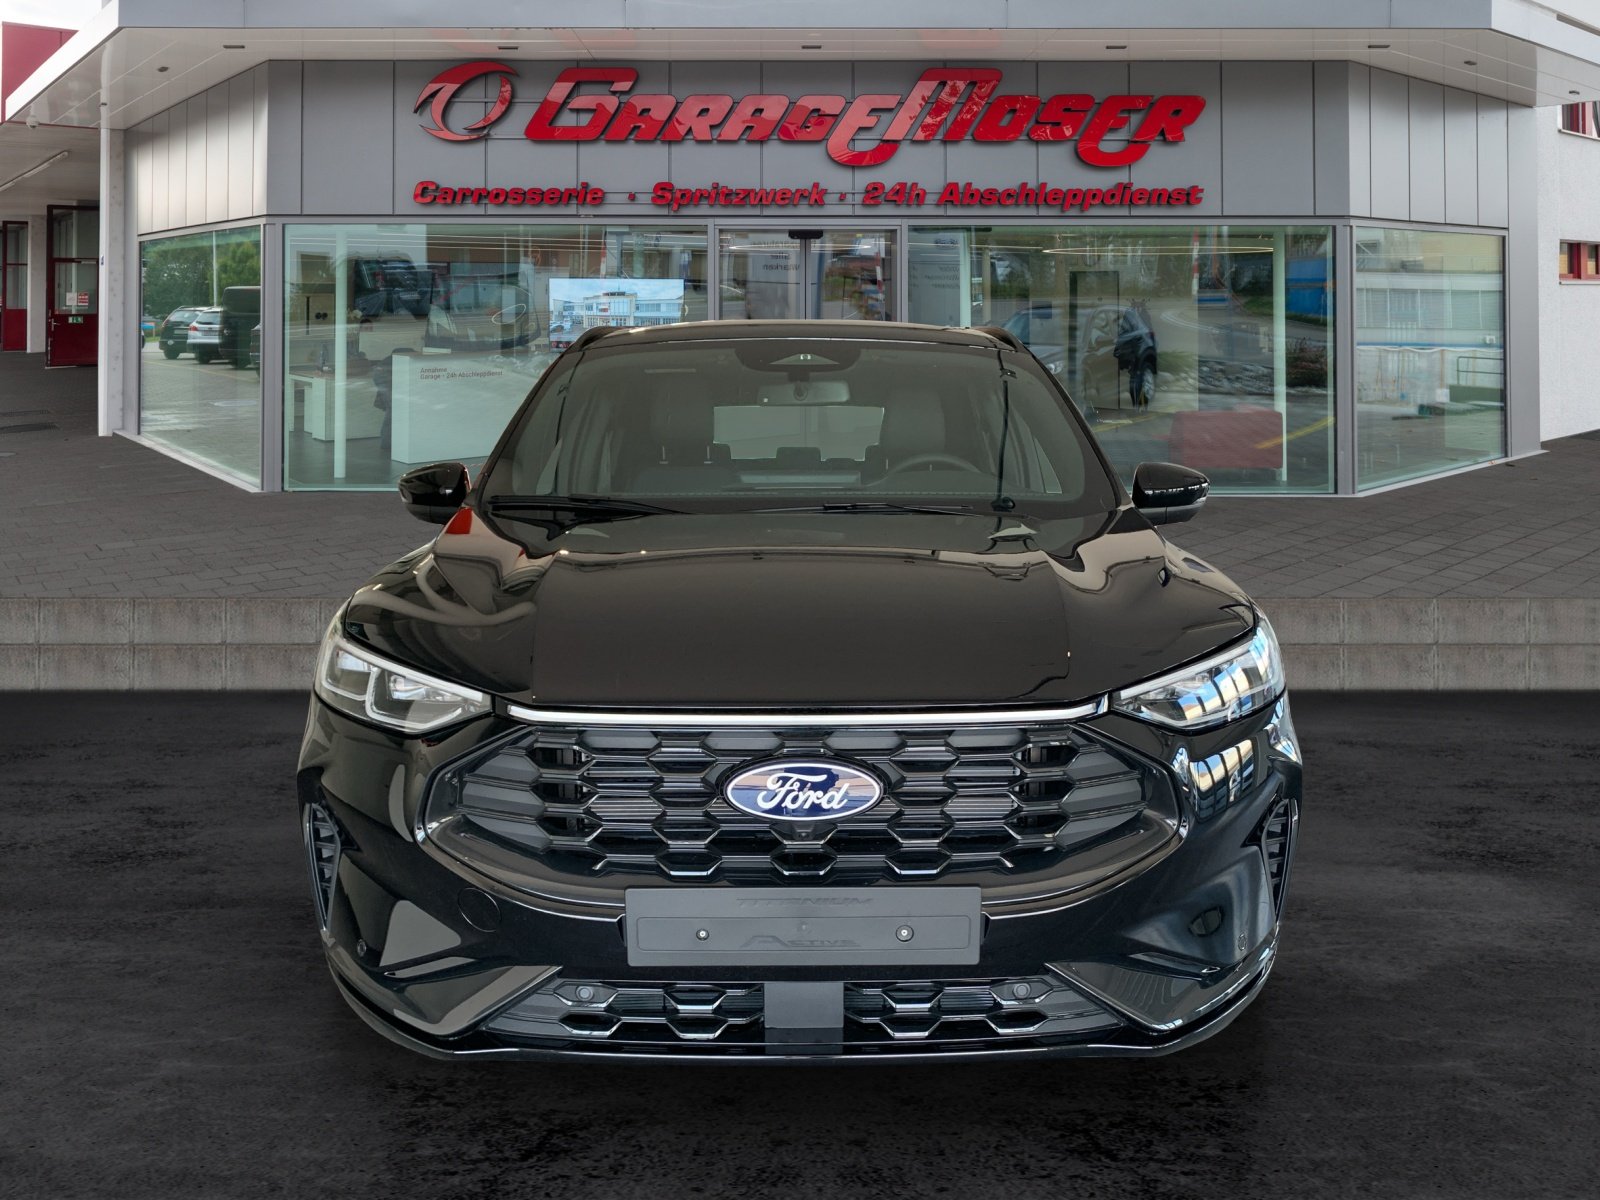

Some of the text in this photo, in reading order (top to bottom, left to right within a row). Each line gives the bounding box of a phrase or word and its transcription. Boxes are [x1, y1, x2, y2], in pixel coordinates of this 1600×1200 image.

[412, 181, 605, 205] Carrosserie
[650, 181, 827, 211] Spritzwerk
[862, 181, 927, 206] 24h
[936, 181, 1204, 212] Abschleppdienst
[756, 772, 850, 810] Ford
